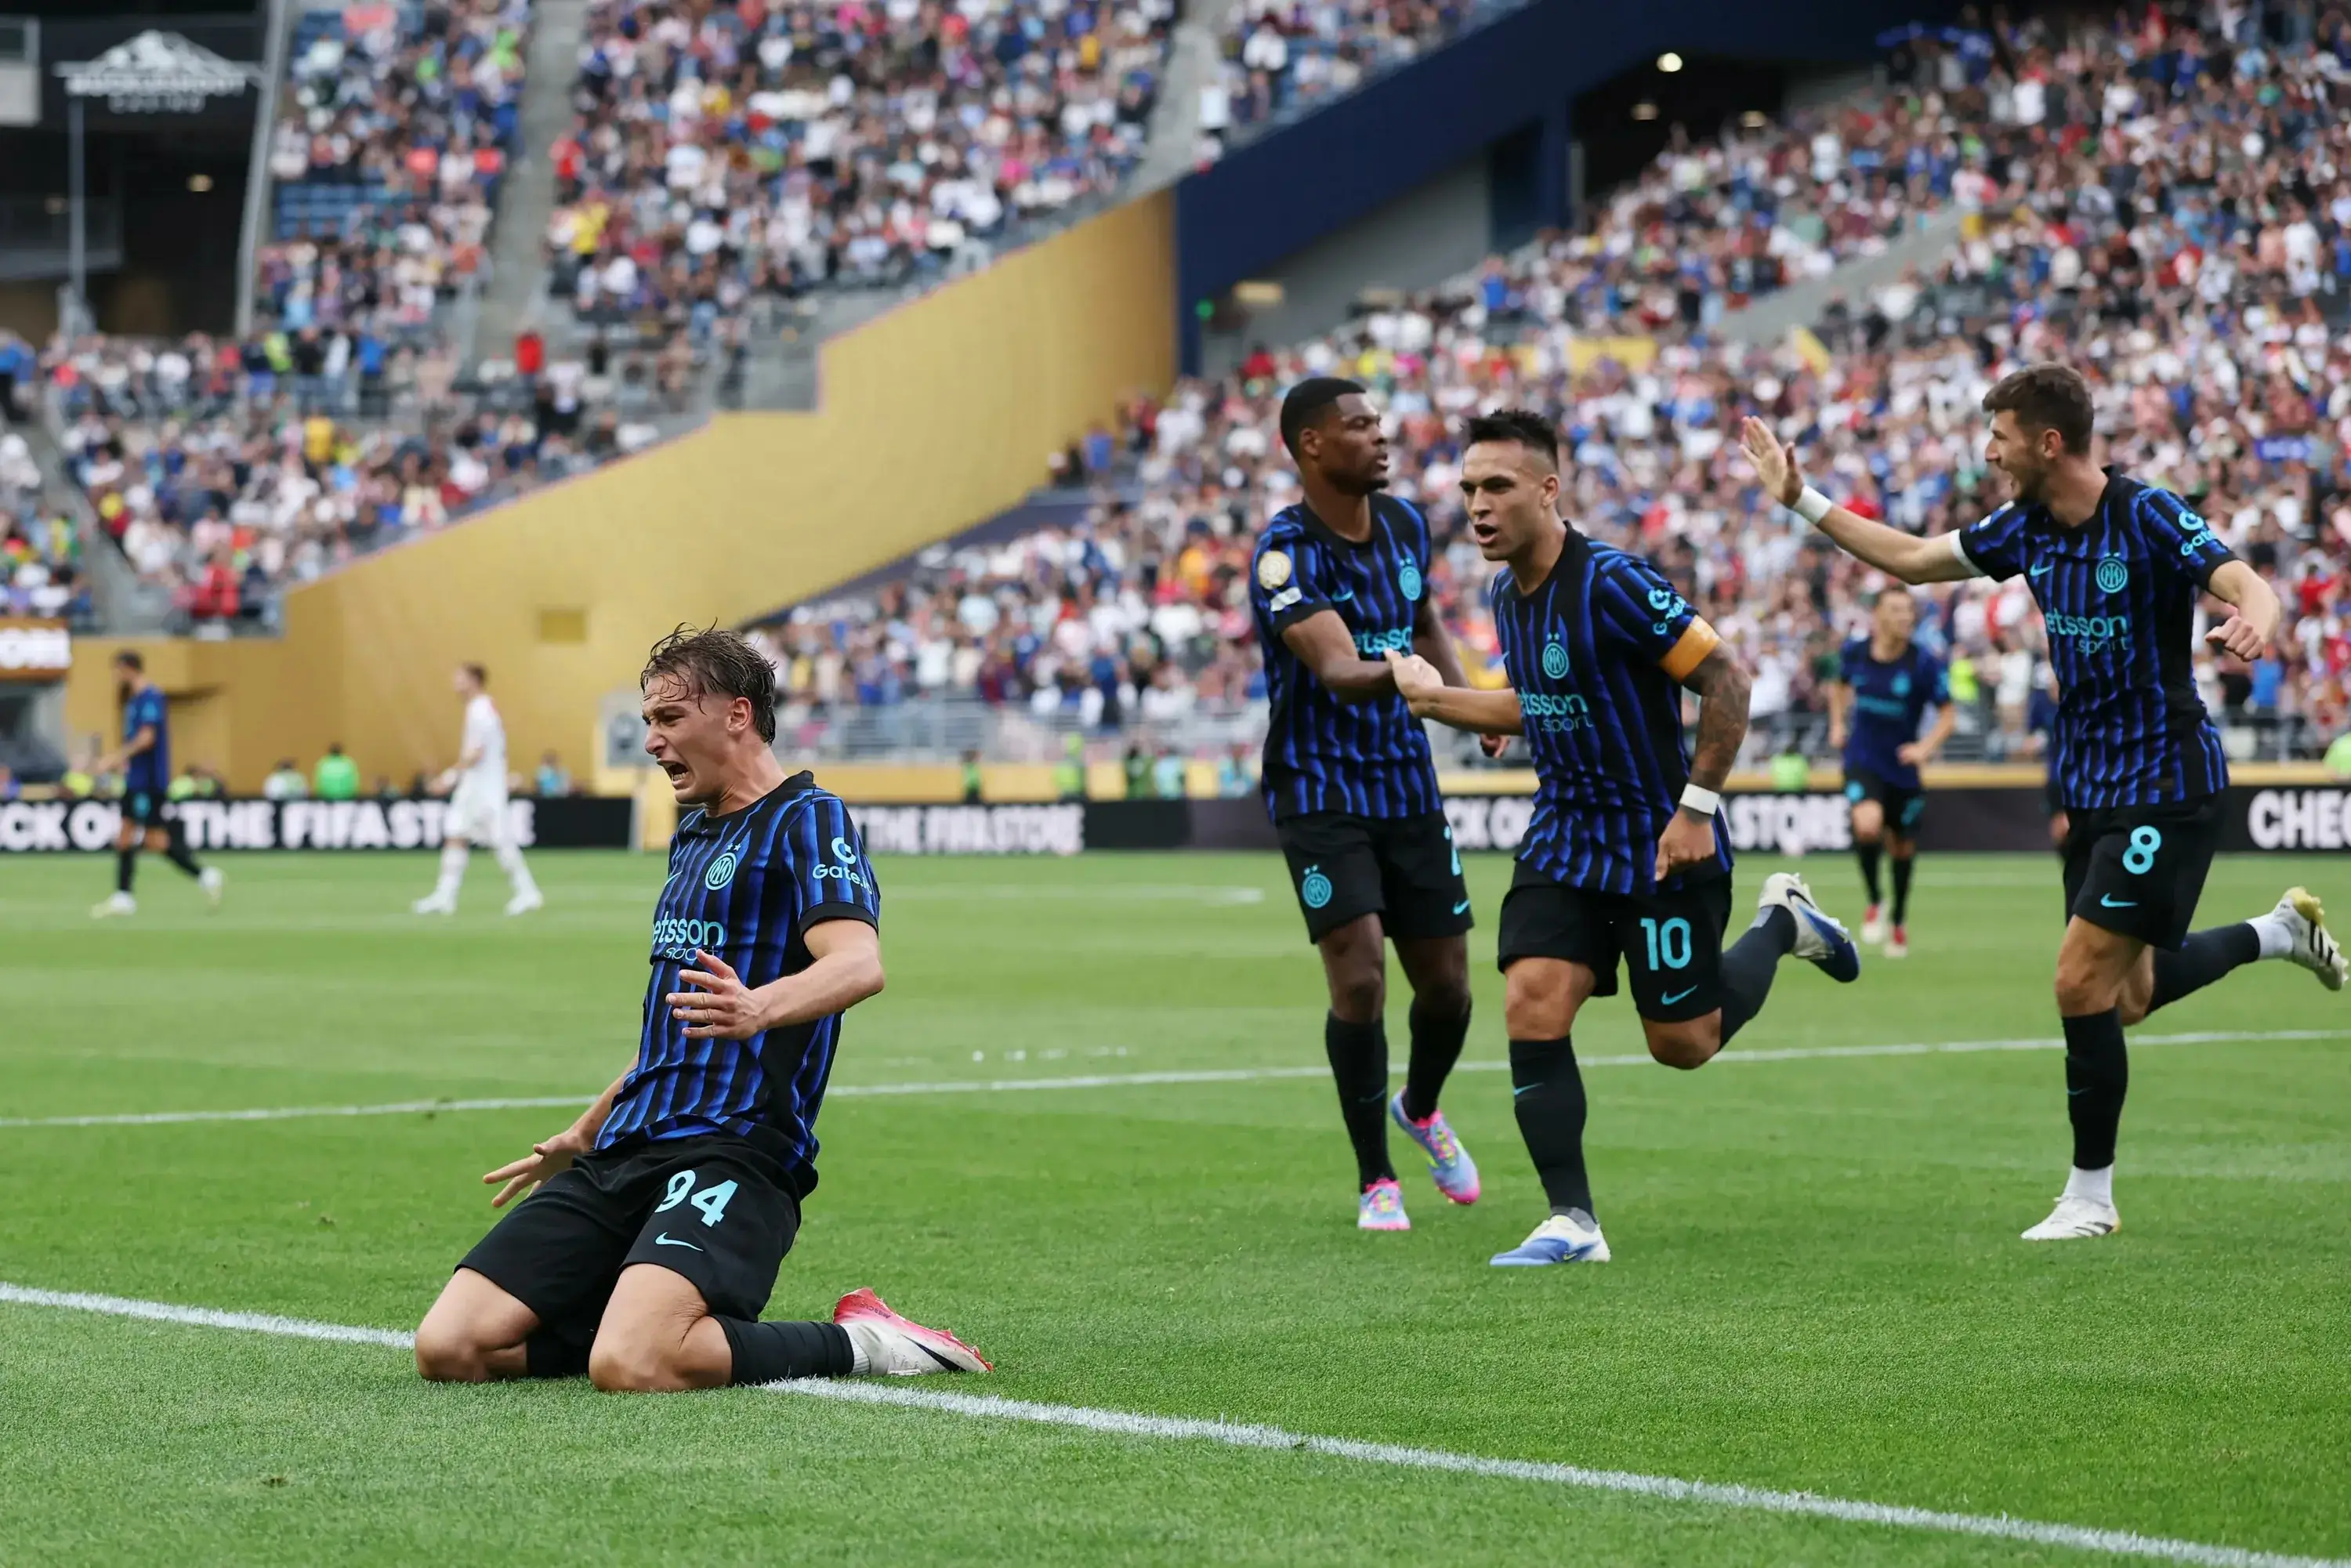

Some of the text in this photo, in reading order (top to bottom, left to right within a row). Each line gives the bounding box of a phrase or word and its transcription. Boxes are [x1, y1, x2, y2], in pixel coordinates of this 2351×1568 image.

[179, 800, 275, 849] THE
[283, 800, 390, 849] FIFA
[389, 799, 536, 849] STE
[1728, 794, 1853, 851] STORE
[2248, 788, 2351, 849] CHE
[2122, 825, 2161, 875] 8
[1640, 917, 1692, 971] 10
[654, 1169, 739, 1228] 94
